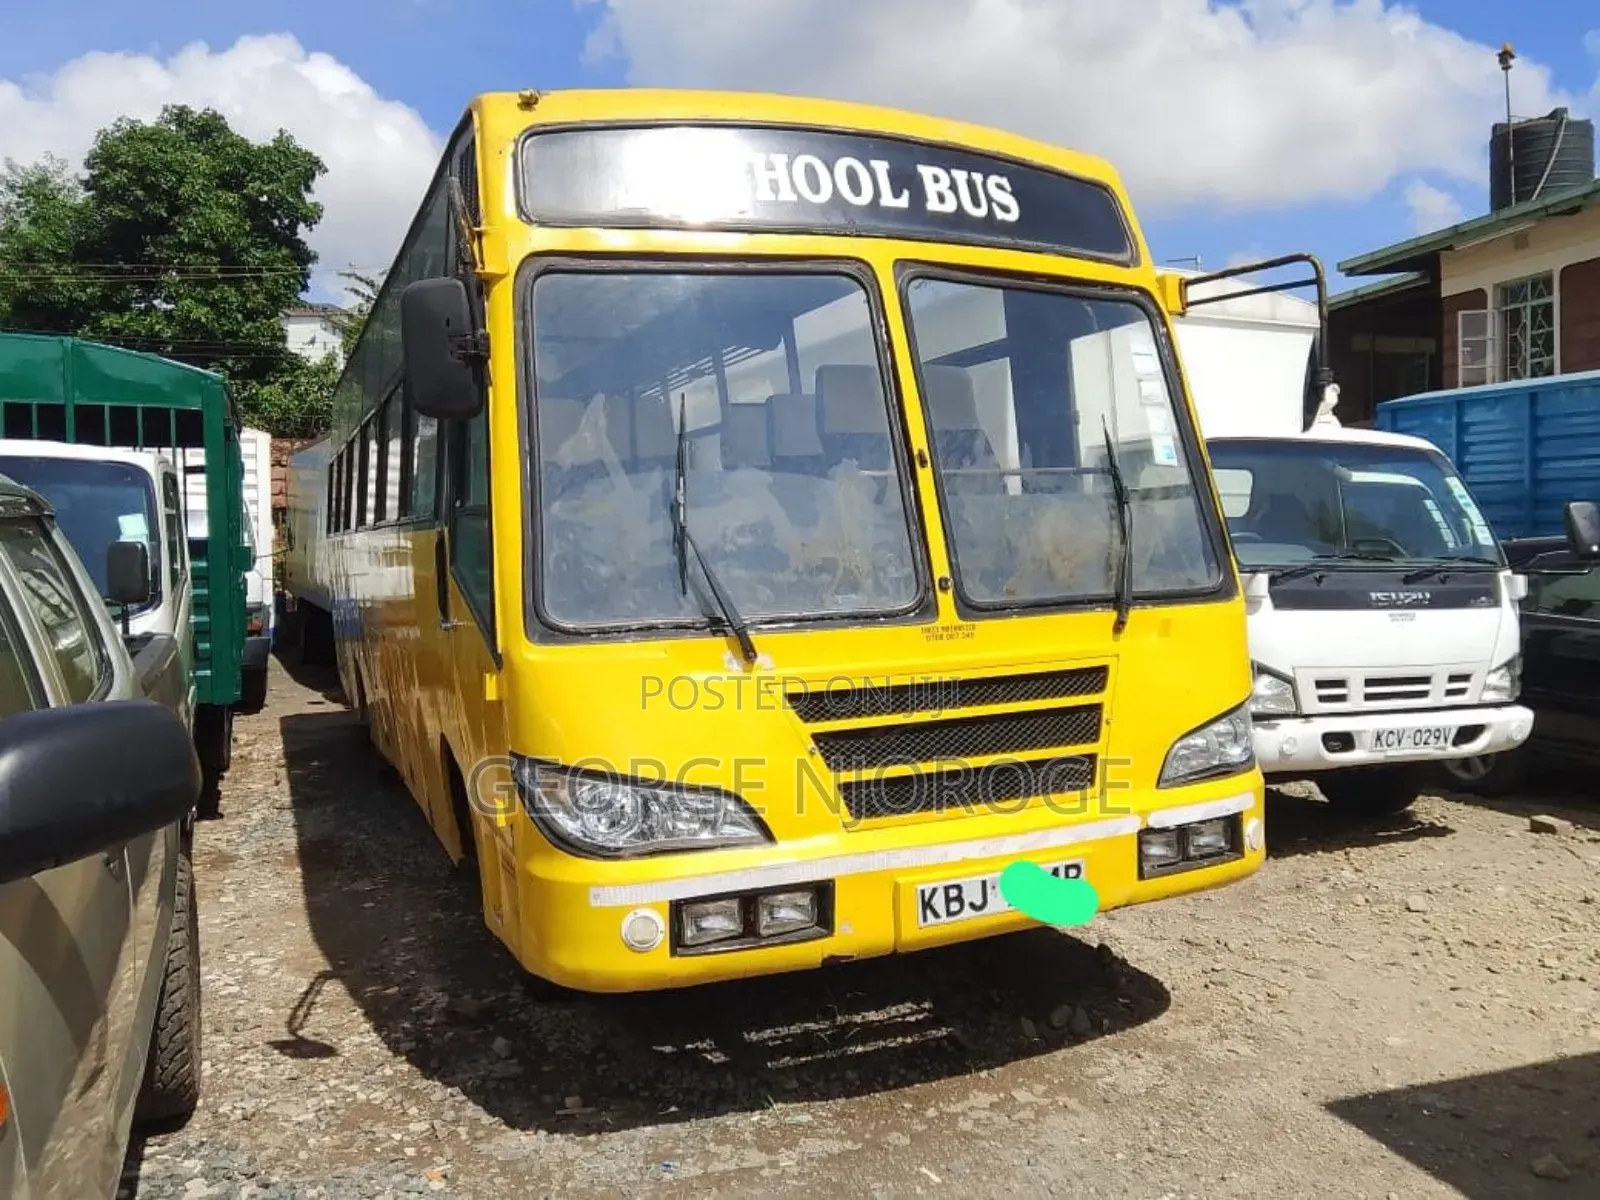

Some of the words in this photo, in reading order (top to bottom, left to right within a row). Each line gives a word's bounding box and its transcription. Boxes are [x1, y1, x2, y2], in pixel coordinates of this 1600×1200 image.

[751, 152, 910, 209] HOOL
[916, 164, 1021, 222] BUS
[1374, 728, 1406, 748] KCV
[1412, 727, 1452, 747] 029V
[919, 879, 989, 923] KBJ
